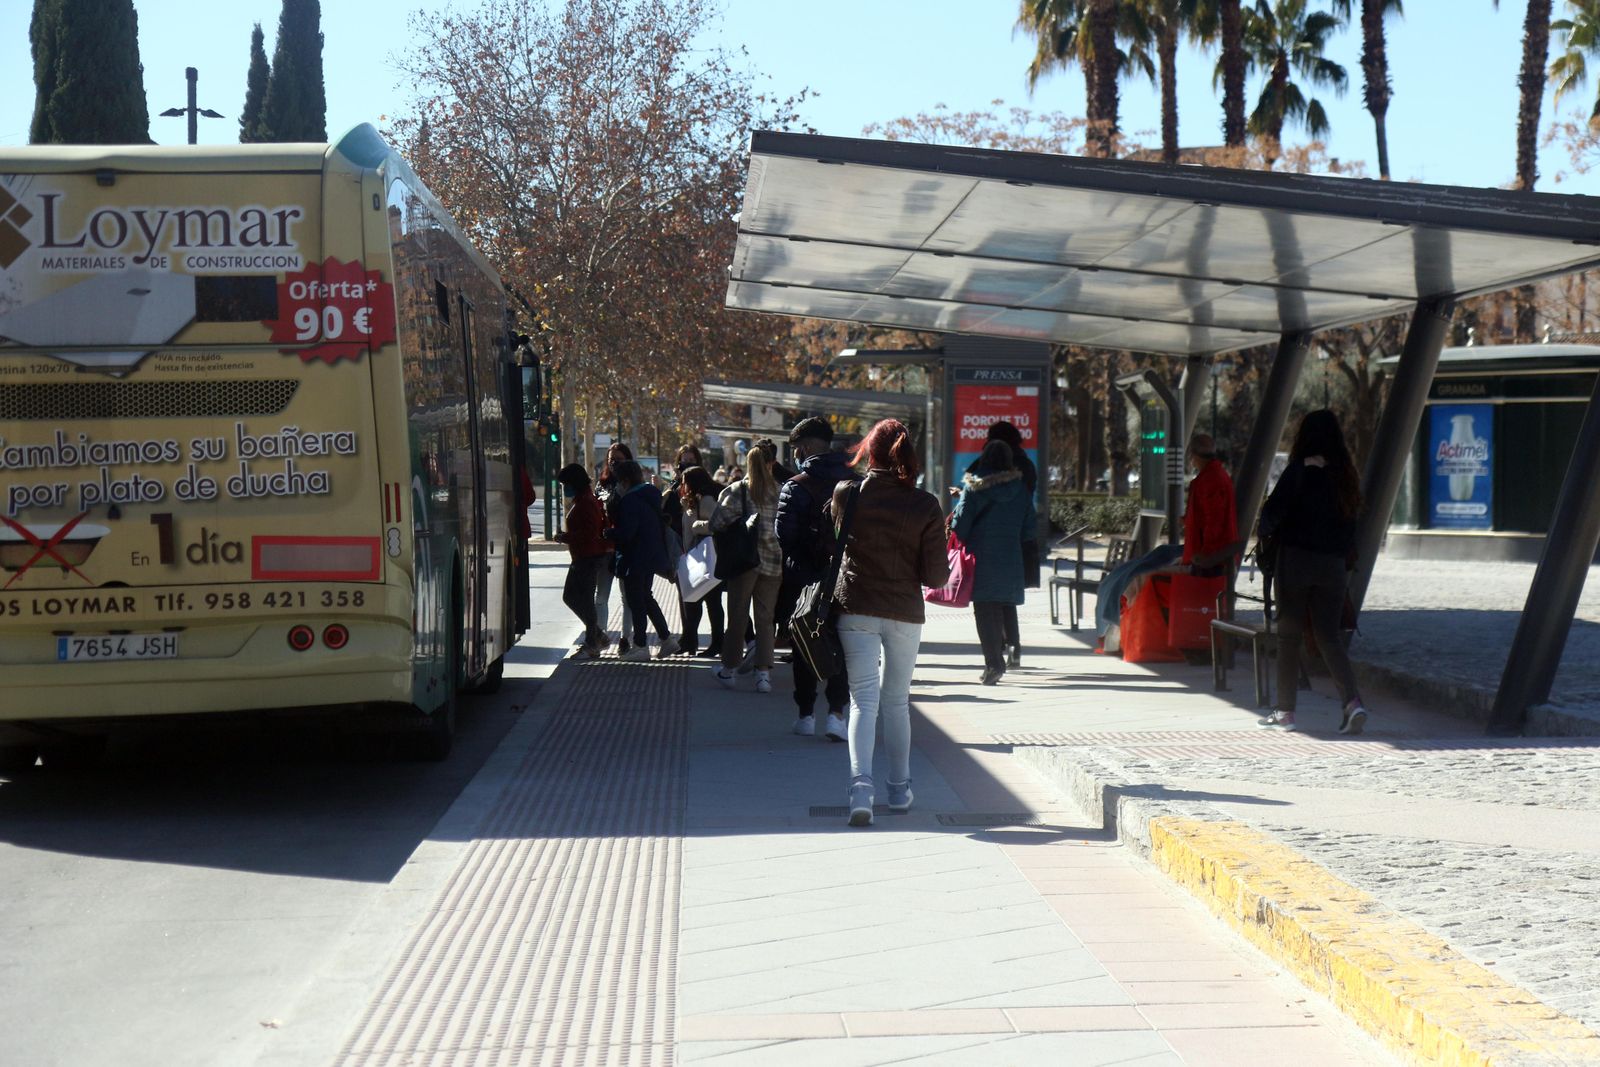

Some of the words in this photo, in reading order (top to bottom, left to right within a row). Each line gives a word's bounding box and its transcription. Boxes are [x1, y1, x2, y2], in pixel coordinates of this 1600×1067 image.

[37, 193, 302, 265] Loymar
[41, 256, 126, 269] MATERIALES
[150, 256, 168, 269] DE
[186, 255, 299, 269] CONSTRUCCION
[294, 307, 343, 341] 90
[352, 307, 374, 335] €
[30, 363, 70, 374] 120x70
[154, 363, 179, 372] Hasta
[181, 363, 193, 372] fin
[195, 363, 205, 372] de
[207, 361, 254, 371] existencias
[973, 370, 1022, 381] PRENSA
[1437, 384, 1487, 396] GRANADA
[1014, 412, 1030, 426] TÚ
[0, 428, 180, 468] ambiamos
[191, 437, 226, 462] su
[235, 421, 357, 459] bañera
[1438, 440, 1489, 460] Actimel
[8, 481, 70, 517] por
[79, 466, 165, 513] plato
[174, 462, 218, 501] de
[227, 459, 330, 499] ducha
[131, 551, 150, 567] En
[150, 512, 175, 566] 1
[186, 527, 244, 566] día
[32, 596, 136, 615] LOYMAR
[155, 594, 193, 611] Tlf.
[205, 592, 251, 609] 958
[263, 591, 306, 608] 421
[321, 590, 366, 607] 358
[72, 637, 128, 658] 7654
[135, 636, 178, 657] JSH
